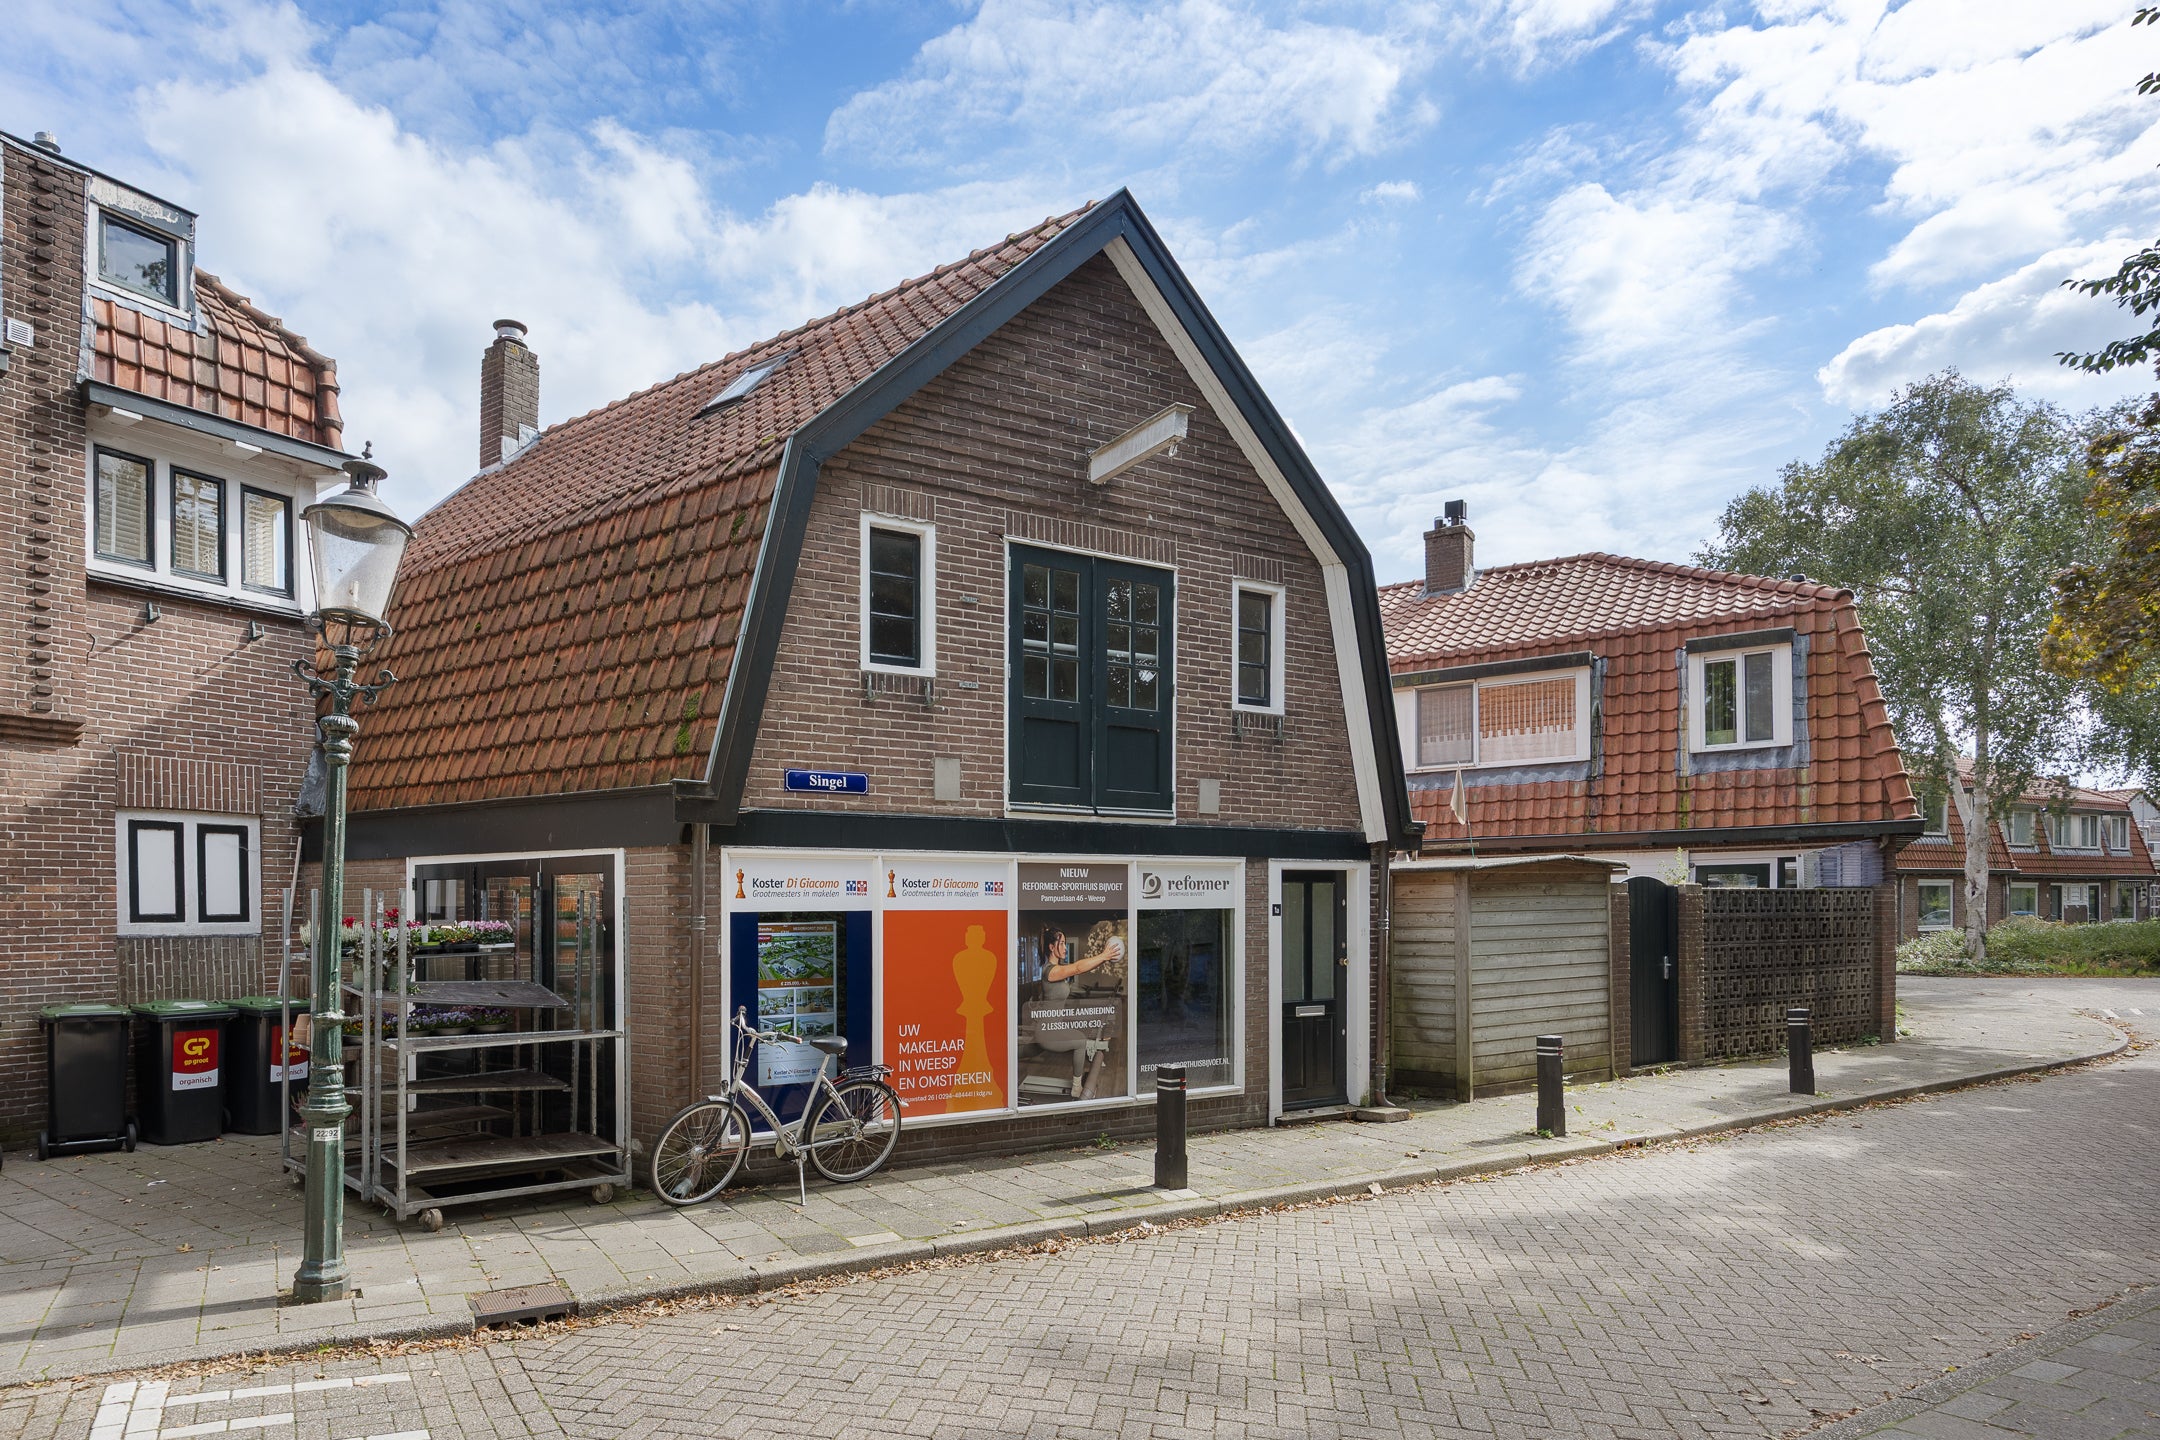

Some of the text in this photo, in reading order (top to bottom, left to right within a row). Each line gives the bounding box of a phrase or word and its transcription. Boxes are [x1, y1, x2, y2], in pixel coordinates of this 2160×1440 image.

[809, 774, 848, 790] Singel
[1060, 868, 1089, 878] NIEUW
[752, 877, 840, 889] Koster Di Giacomo
[902, 878, 979, 889] Koster Di Giacomo
[1022, 882, 1123, 892] REFORMER-SPORTHUIS BIJVOET
[1167, 874, 1230, 891] reformer
[752, 889, 840, 898] Grootmeesters in makelen
[901, 889, 979, 897] Grootmeesters in makelen
[1040, 895, 1076, 903] Pampuslaan
[1088, 895, 1106, 903] Weesp
[1031, 1006, 1115, 1019] INTRODUCTIE AANBIEDING
[899, 1023, 921, 1037] UW
[1041, 1019, 1106, 1031] 2 LESSEN VOOR €30,-
[898, 1038, 965, 1055] MAKELAAR
[193, 1057, 209, 1065] groot
[899, 1056, 957, 1073] IN WEESP
[179, 1075, 213, 1086] organisch
[899, 1071, 992, 1090] EN OMSTREKEN
